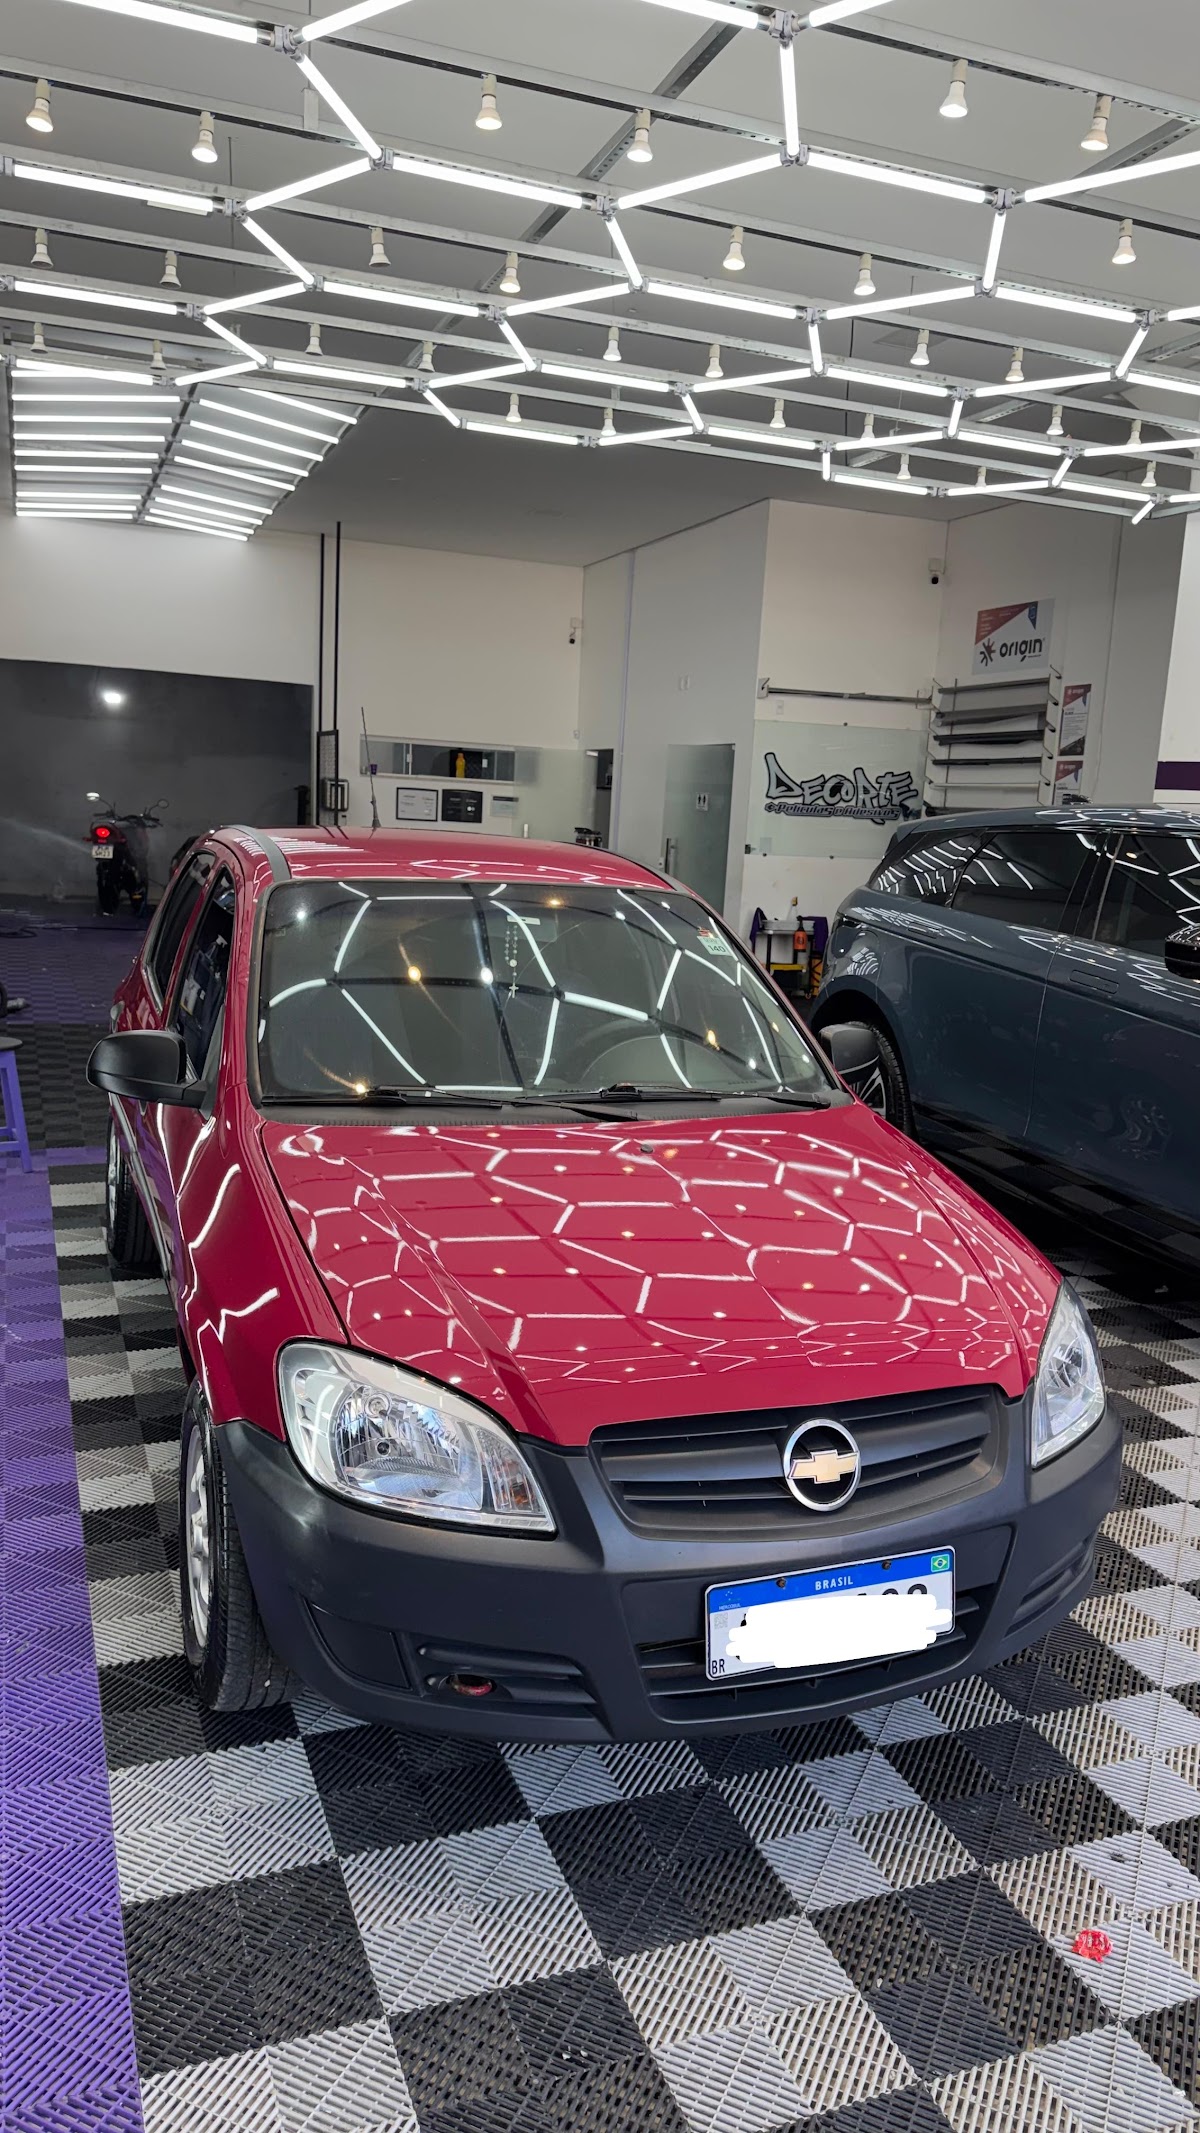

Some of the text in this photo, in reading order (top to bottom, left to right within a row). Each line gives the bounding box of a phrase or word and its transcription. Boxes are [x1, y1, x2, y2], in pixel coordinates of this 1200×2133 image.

[1000, 638, 1043, 662] origin
[815, 1575, 854, 1591] BRASIL
[711, 1658, 725, 1675] BR
